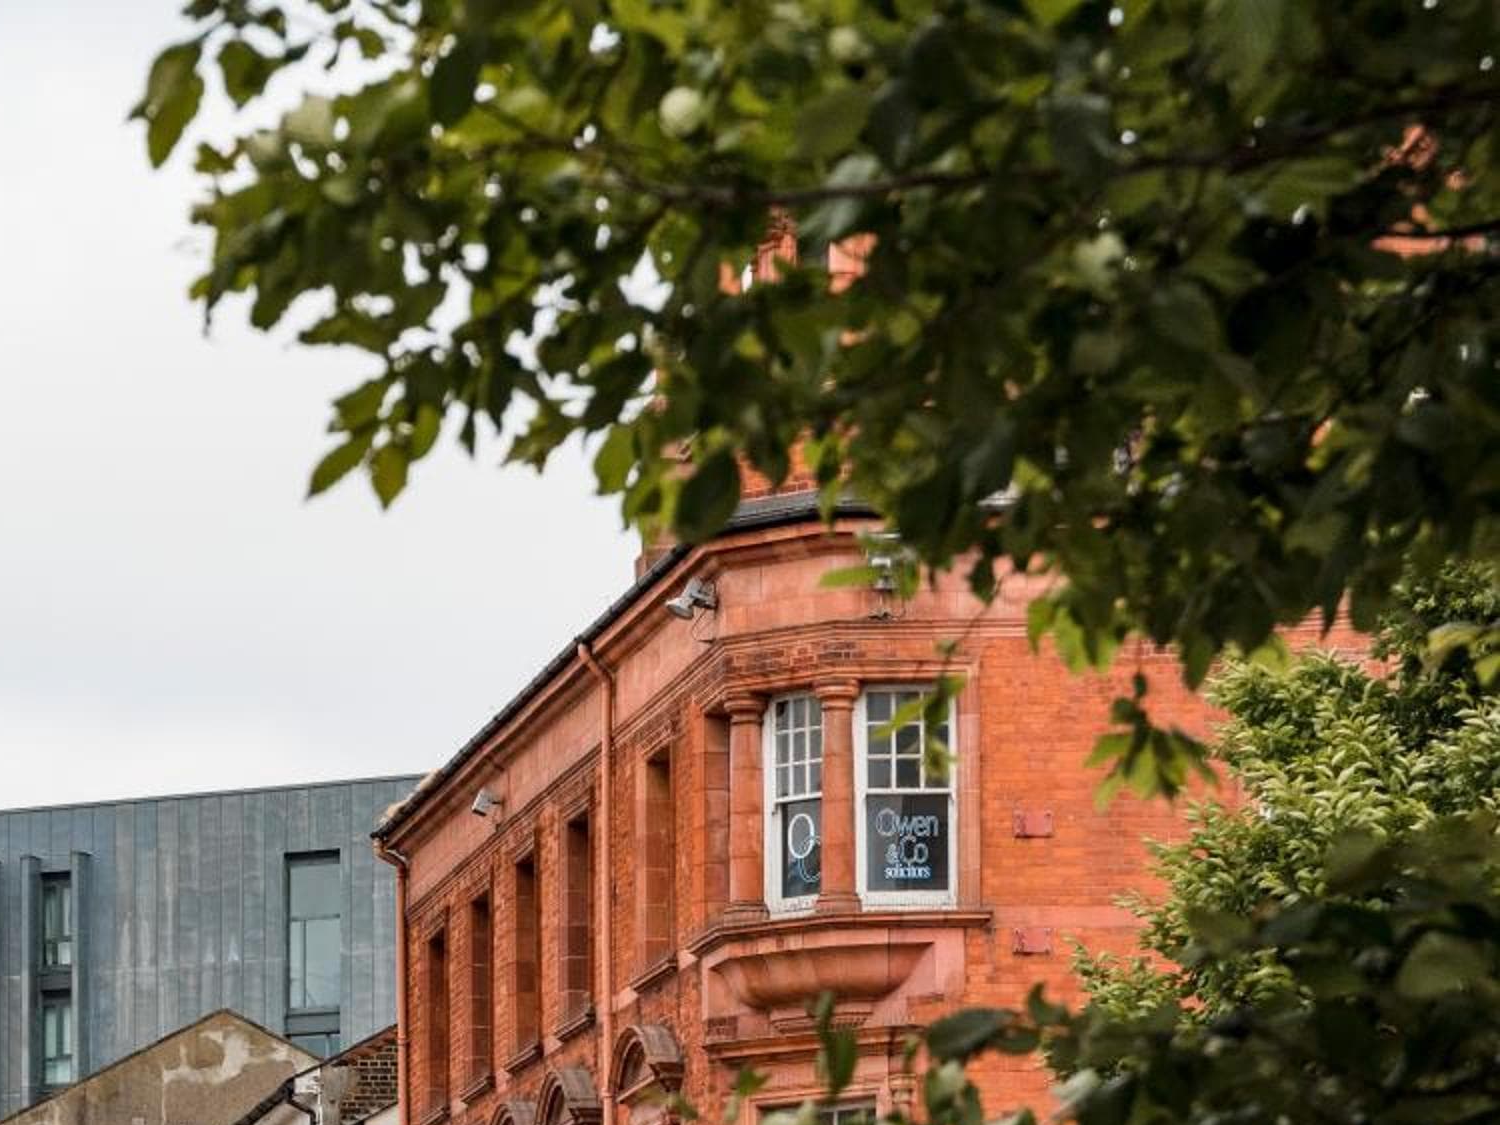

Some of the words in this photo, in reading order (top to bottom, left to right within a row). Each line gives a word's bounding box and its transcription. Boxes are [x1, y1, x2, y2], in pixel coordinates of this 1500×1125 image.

[876, 808, 938, 837] Owen
[900, 835, 928, 865] Co
[884, 863, 931, 880] solicitors
